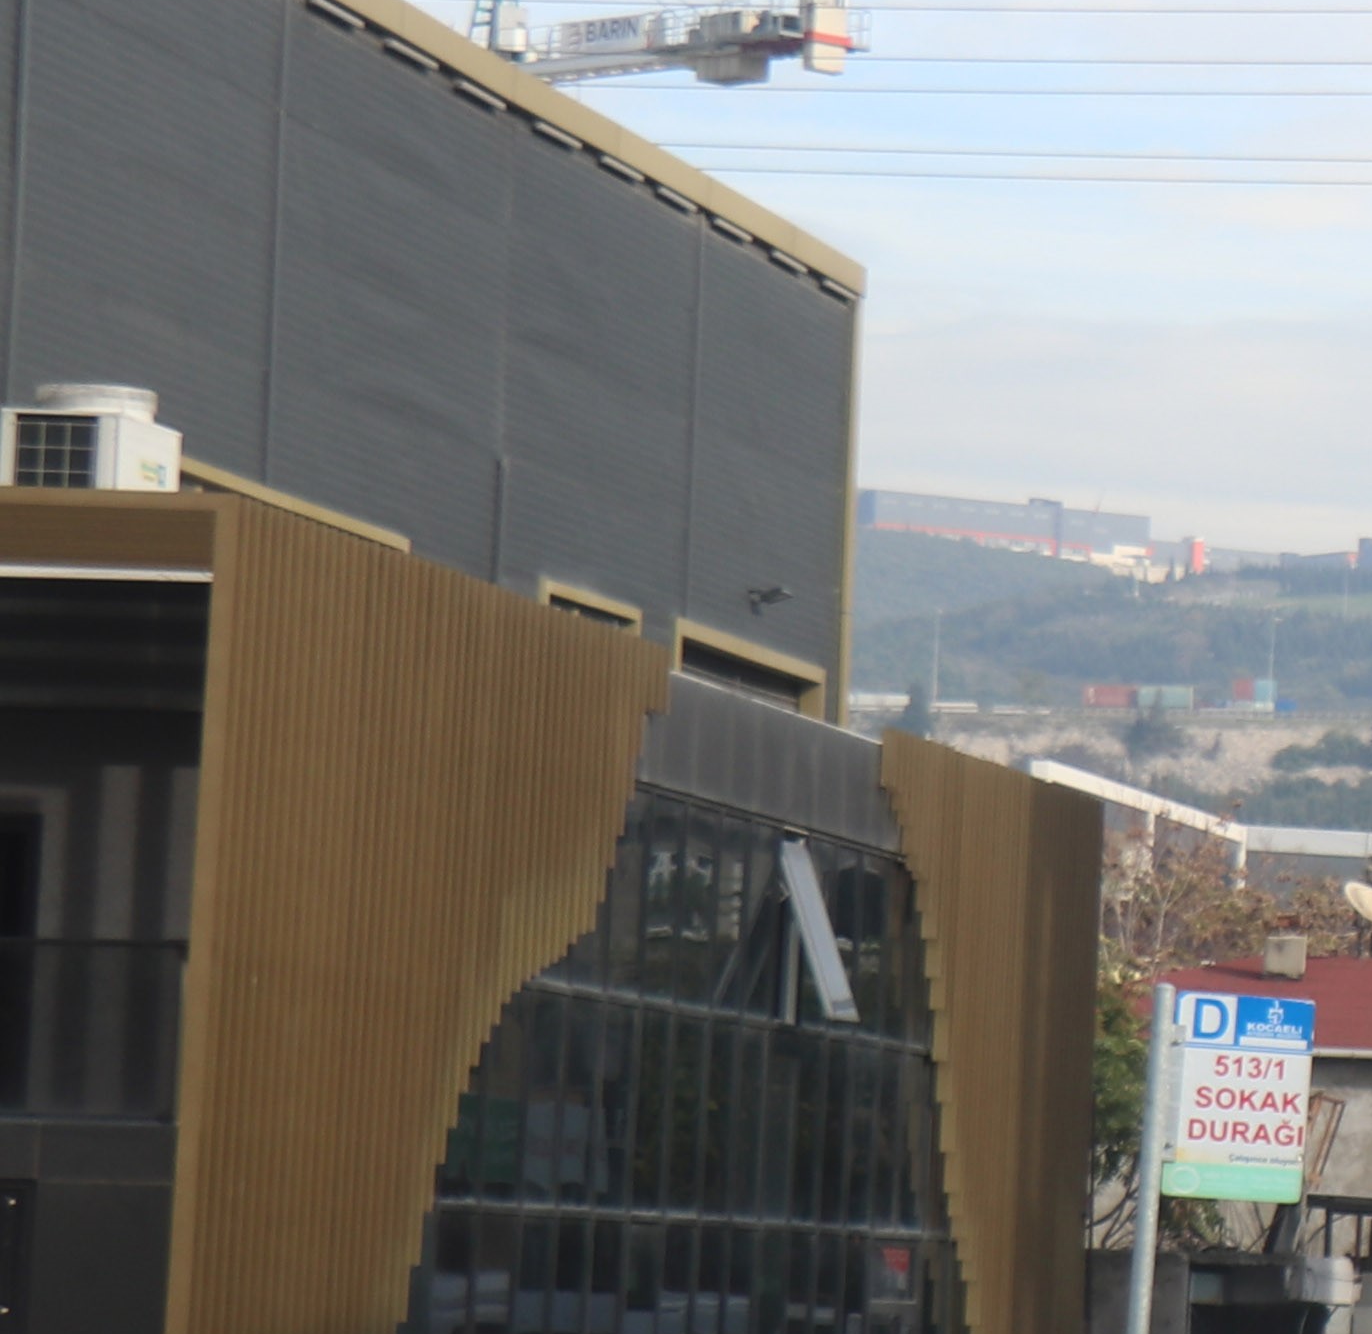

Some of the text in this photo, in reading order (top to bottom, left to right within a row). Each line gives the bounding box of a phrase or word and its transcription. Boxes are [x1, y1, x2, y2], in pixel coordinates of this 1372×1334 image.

[585, 17, 639, 43] BARIN
[1192, 998, 1230, 1040] D
[1213, 1054, 1286, 1081] 513/1
[1194, 1085, 1302, 1114] SOKAK
[1187, 1118, 1305, 1148] DURAĞI
